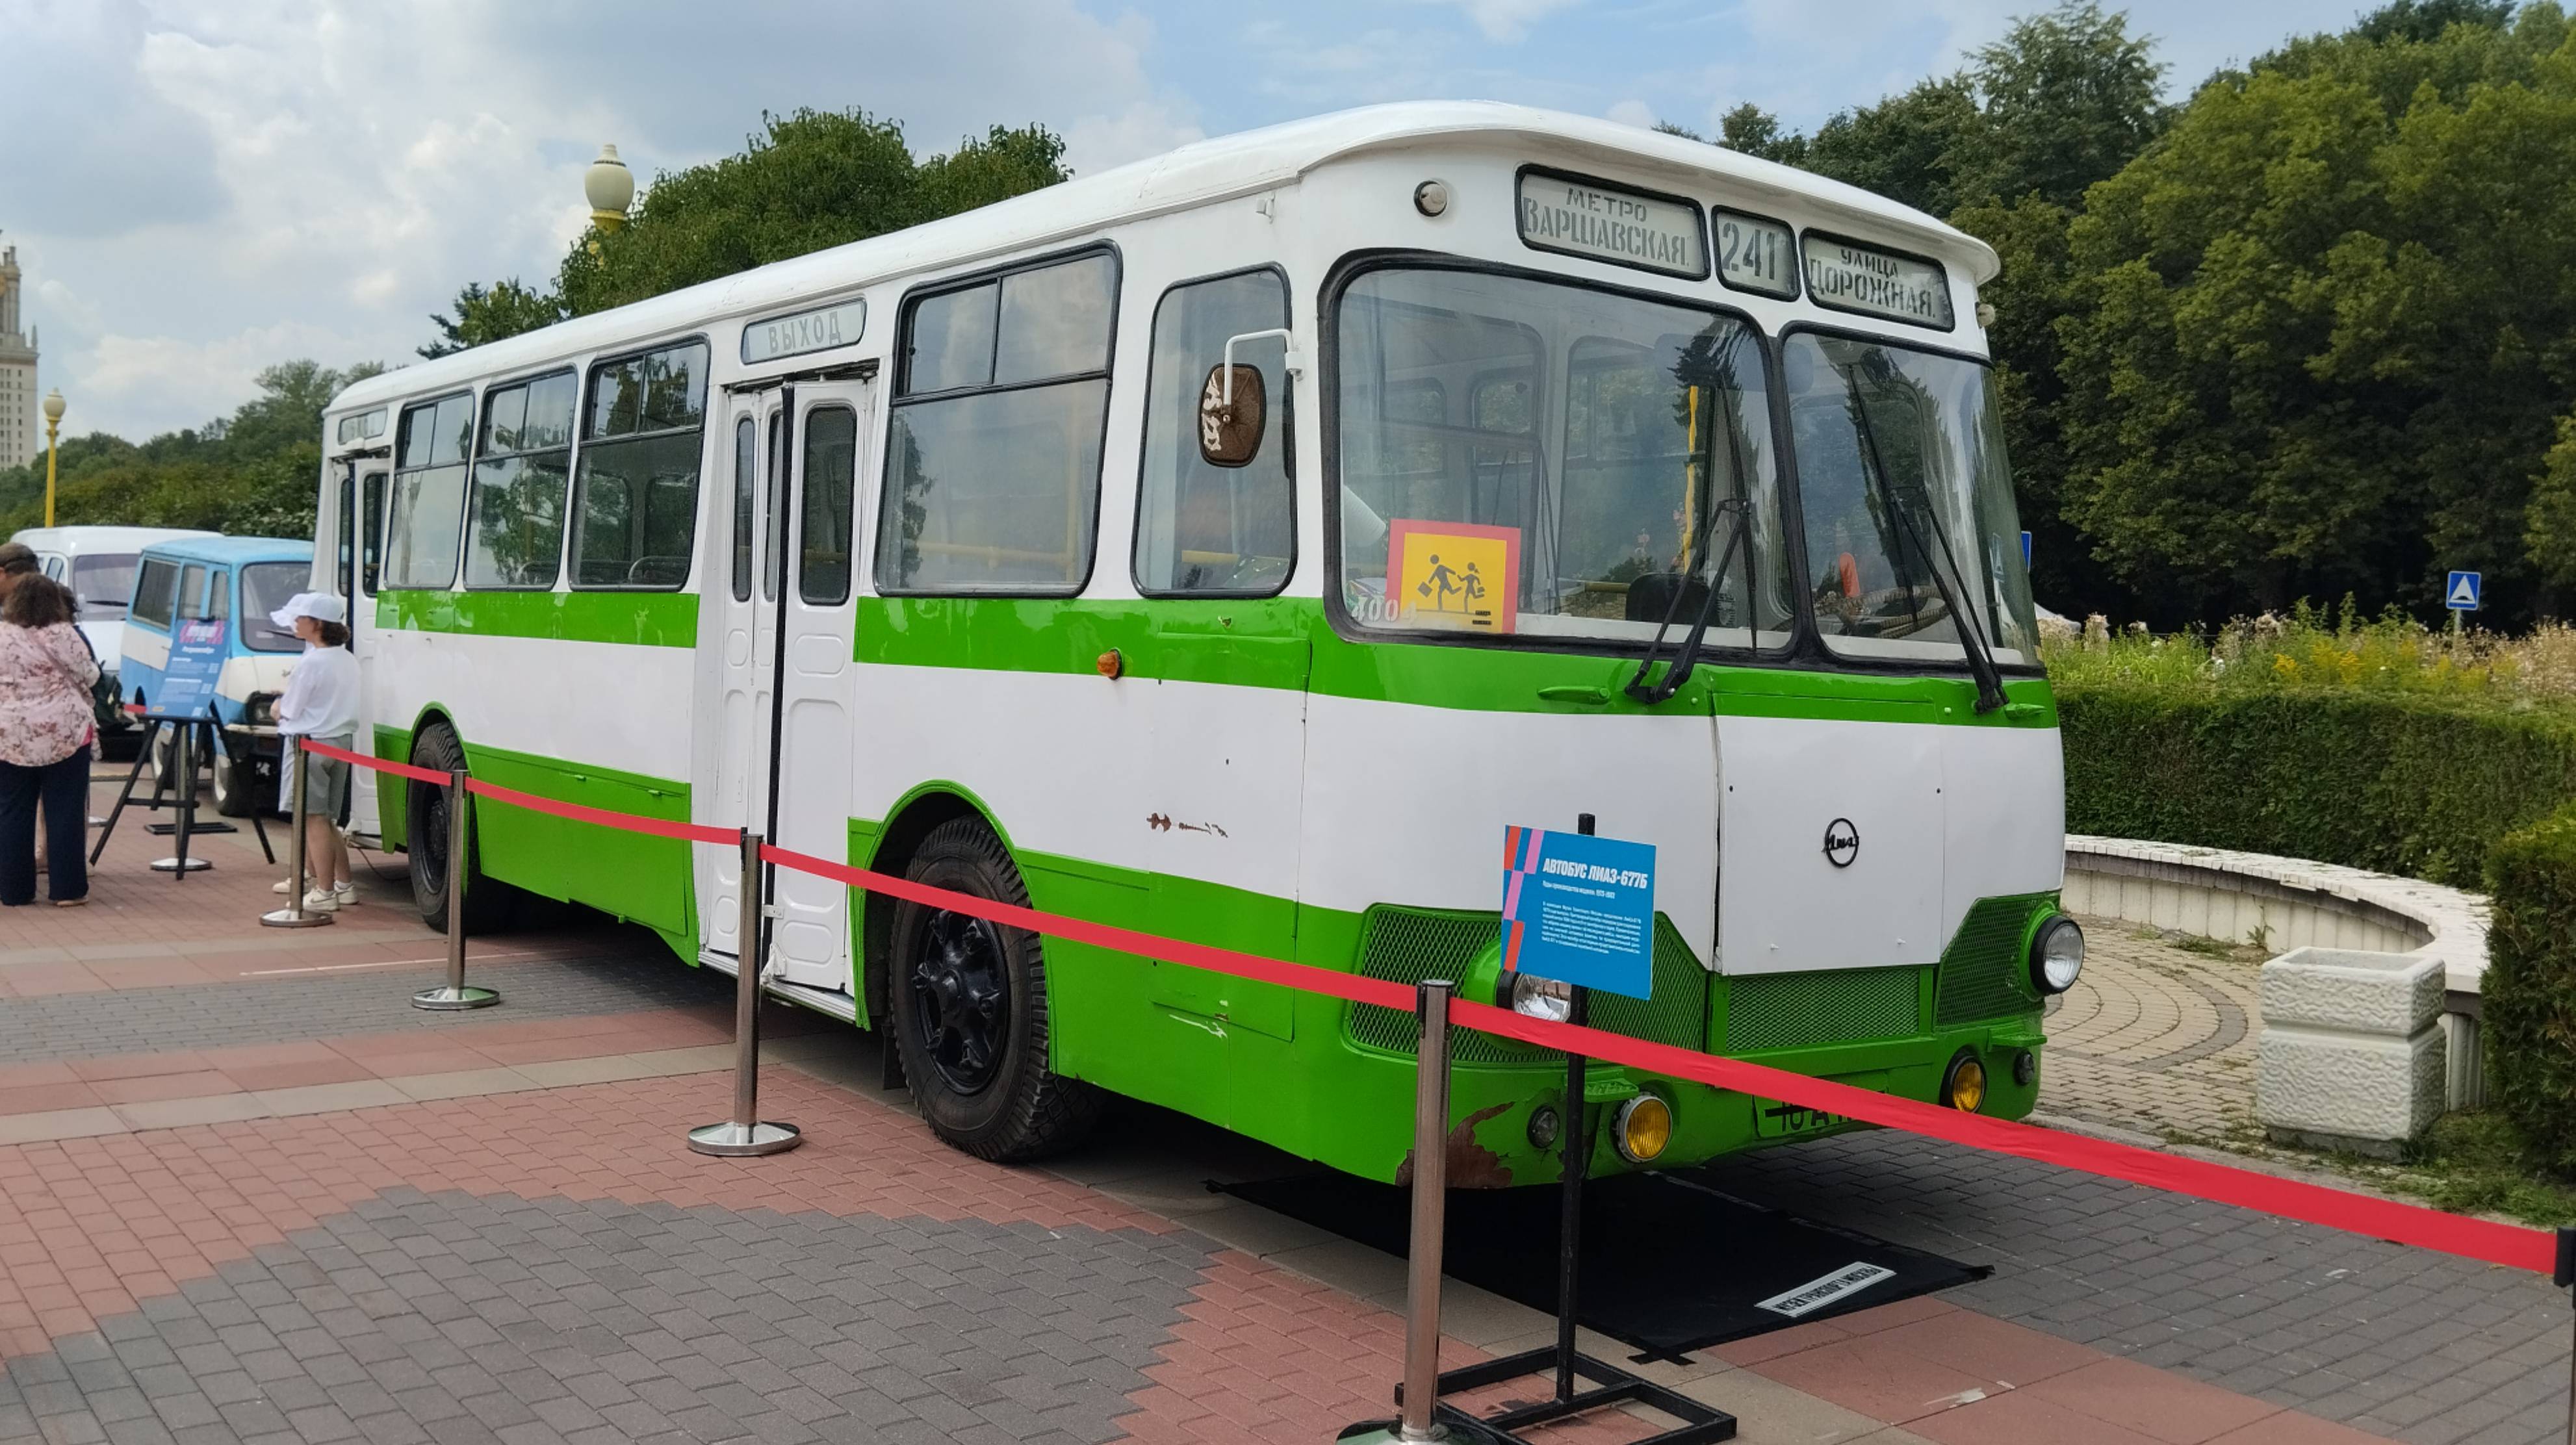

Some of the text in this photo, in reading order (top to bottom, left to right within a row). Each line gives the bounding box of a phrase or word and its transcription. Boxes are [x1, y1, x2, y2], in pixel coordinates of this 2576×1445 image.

[1566, 188, 1647, 222] МЕТРО
[1721, 222, 1777, 281] 241
[1840, 248, 1899, 278] УЛИЦА
[768, 311, 842, 354] ВЫХОД
[1542, 858, 1649, 889] АВТОБУС ЛИАЗ-677Б
